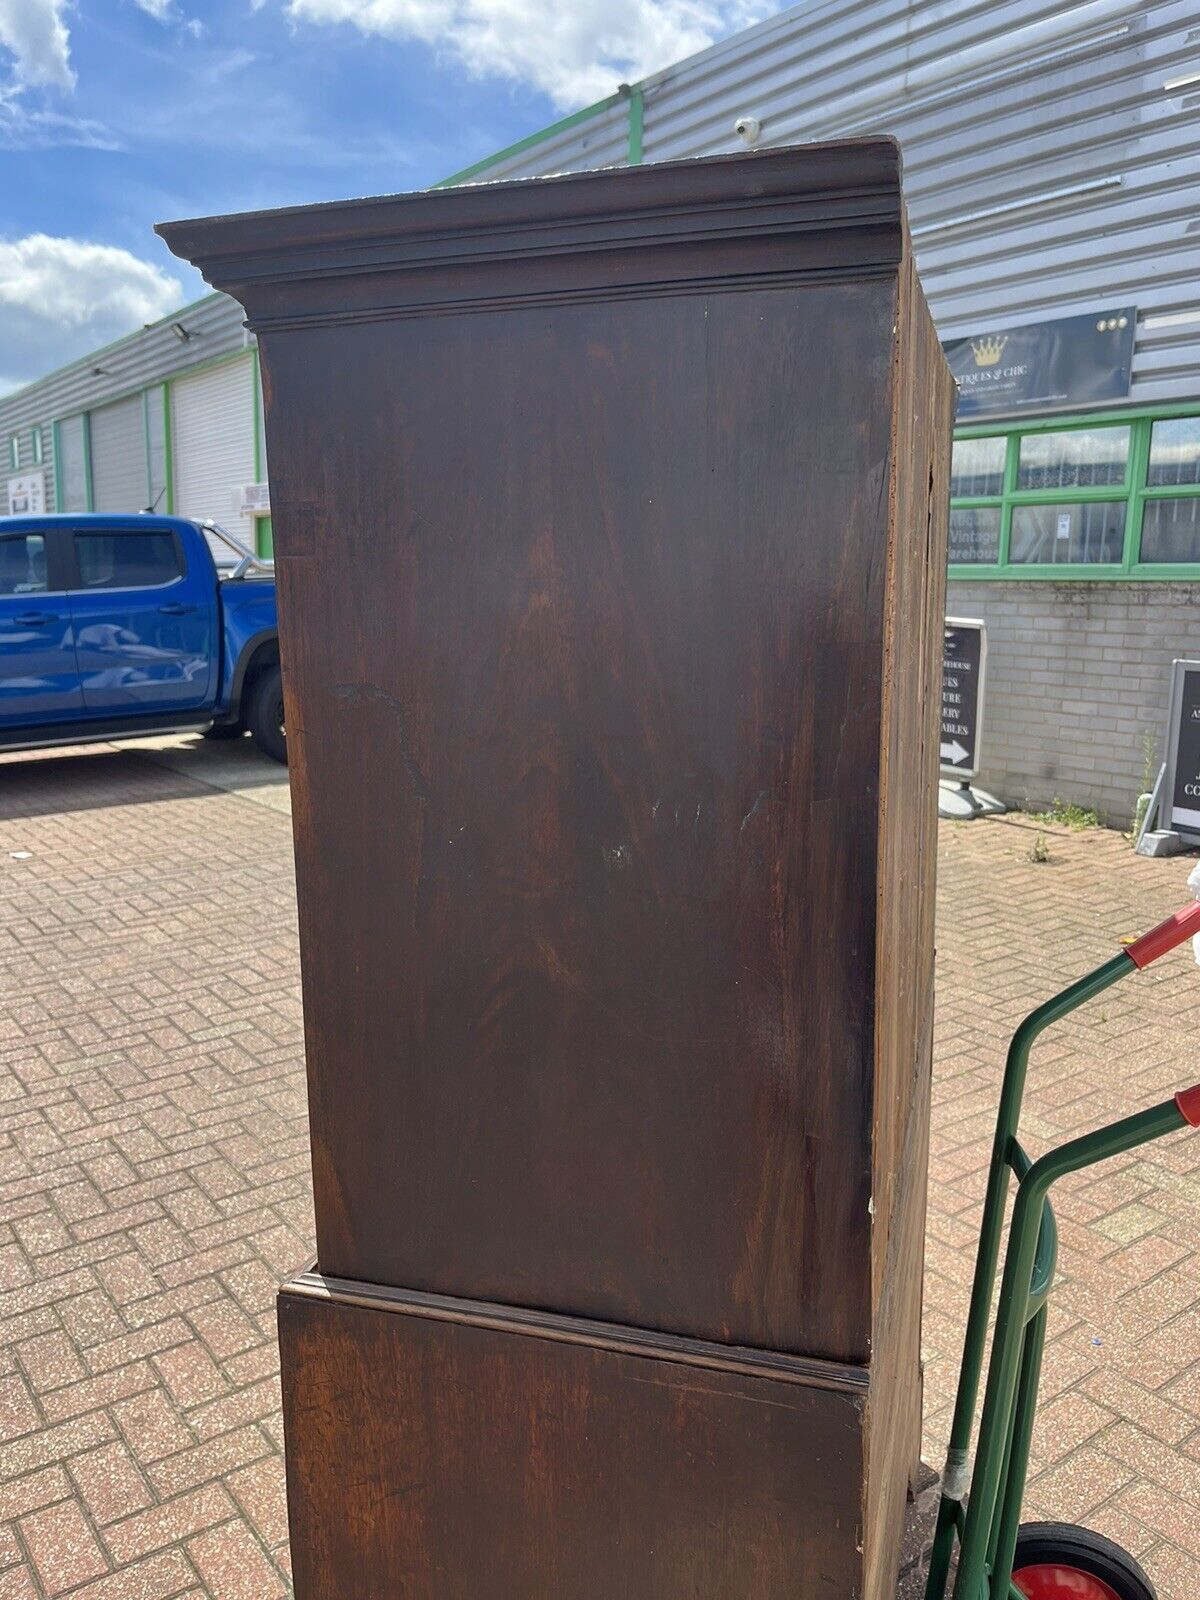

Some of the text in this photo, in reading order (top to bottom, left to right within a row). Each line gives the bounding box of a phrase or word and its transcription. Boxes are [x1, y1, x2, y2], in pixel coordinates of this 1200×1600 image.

[956, 371, 991, 384] TIQUES
[950, 529, 998, 545] Vintage
[948, 546, 998, 560] arehous
[942, 692, 961, 704] URE
[942, 707, 959, 719] ERY
[941, 722, 969, 736] ABLES
